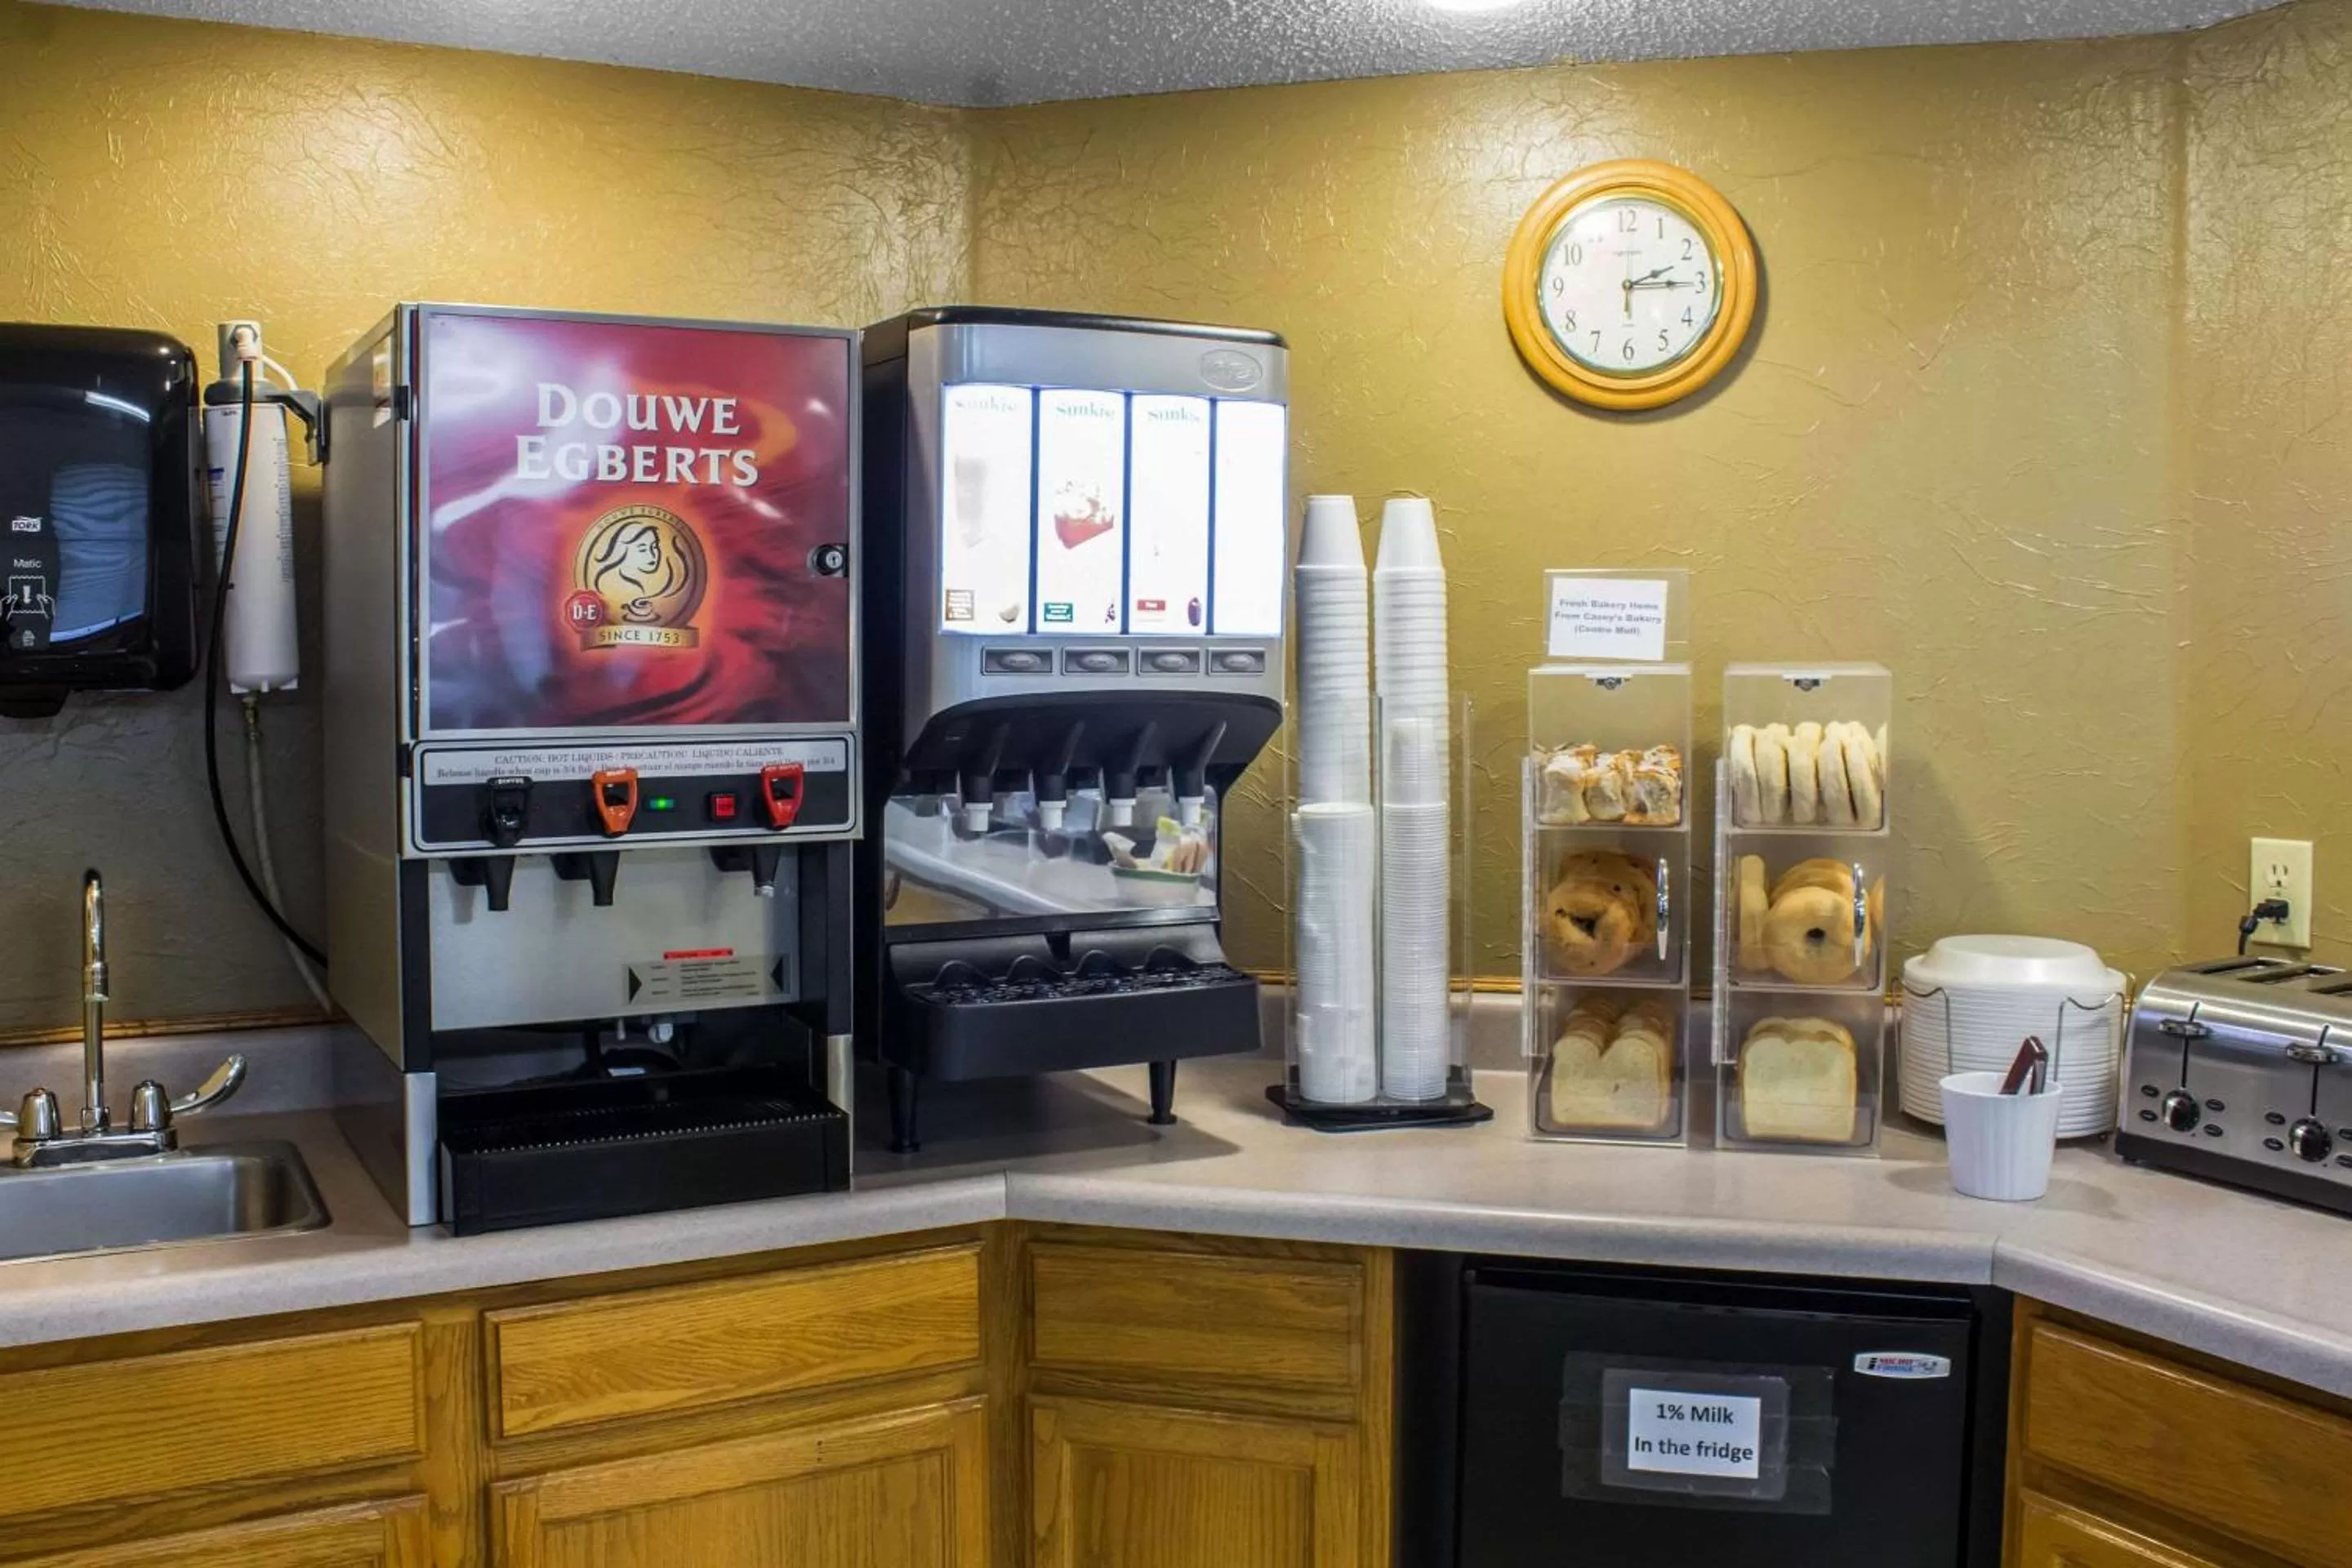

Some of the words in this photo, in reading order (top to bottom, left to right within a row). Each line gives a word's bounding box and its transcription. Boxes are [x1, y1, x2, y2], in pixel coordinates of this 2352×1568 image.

[1618, 210, 1637, 233] 12
[1657, 217, 1664, 238] 1
[1564, 243, 1582, 266] 10
[1681, 238, 1693, 261] 2
[1552, 277, 1564, 298] 9
[1695, 271, 1706, 294] 3
[1566, 310, 1576, 333] 8
[1681, 305, 1694, 327] 4
[1590, 330, 1601, 353] 7
[1622, 338, 1635, 361] 6
[1658, 328, 1669, 352] 5
[13, 520, 39, 531] TORK
[13, 558, 42, 568] Matic
[1559, 598, 1588, 608] Fresh
[1590, 599, 1628, 611] Bakery
[1554, 610, 1581, 619] From
[1625, 613, 1663, 625] Bakery
[599, 630, 641, 642] SINCE
[648, 631, 681, 644] 1753
[1656, 1403, 1685, 1421] 1%
[1690, 1405, 1735, 1424] Milk
[1634, 1436, 1653, 1453] In
[1657, 1437, 1691, 1456] the
[1695, 1440, 1754, 1463] fridge
